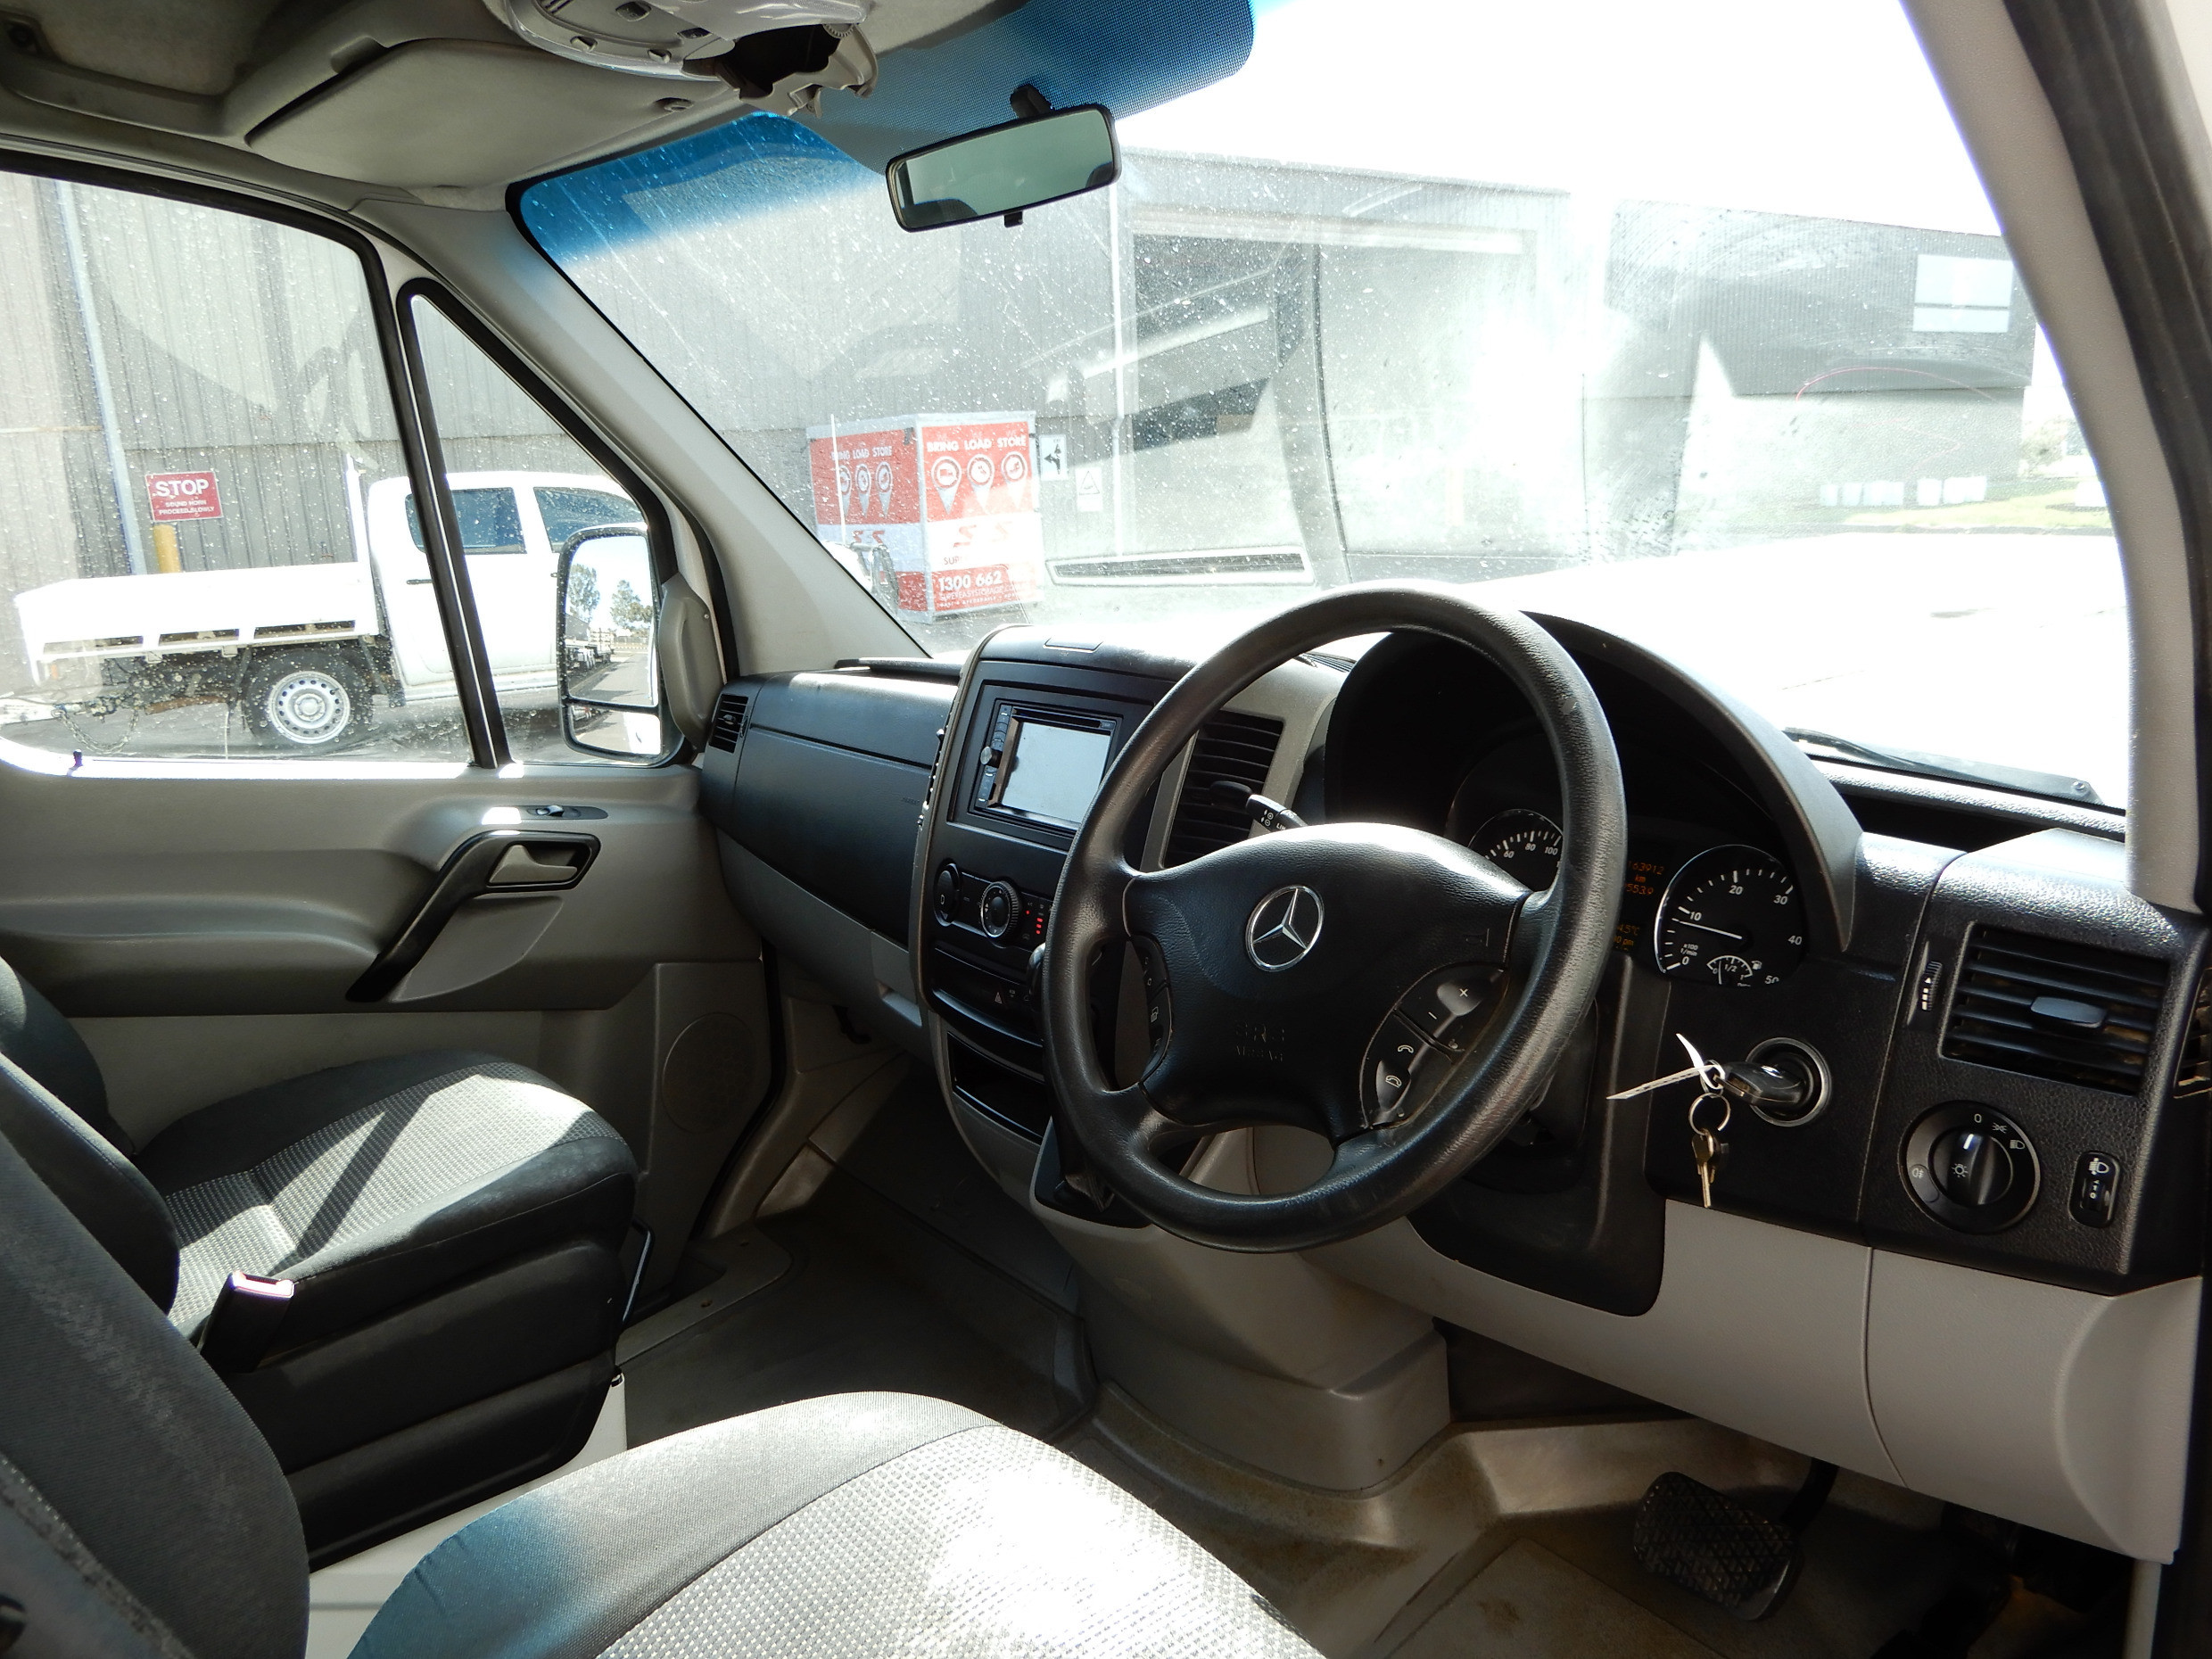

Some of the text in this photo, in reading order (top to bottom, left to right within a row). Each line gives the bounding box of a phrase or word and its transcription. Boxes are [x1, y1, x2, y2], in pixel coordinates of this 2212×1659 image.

[927, 435, 1027, 452] BRING LOAD STORE
[853, 448, 870, 459] LOAD
[872, 446, 893, 457] STORE
[155, 479, 209, 497] STOP
[938, 571, 1003, 591] 1300 662
[1525, 842, 1536, 851] 80
[1544, 846, 1558, 855] 100
[1503, 850, 1515, 859] 60
[1729, 885, 1743, 895] 20
[1773, 895, 1788, 904] 30
[1689, 911, 1702, 921] 10
[1787, 935, 1803, 945] 40
[1683, 943, 1698, 951] x100
[1680, 948, 1697, 956] 1/min
[1682, 956, 1689, 965] 0
[1725, 963, 1737, 972] 1/2
